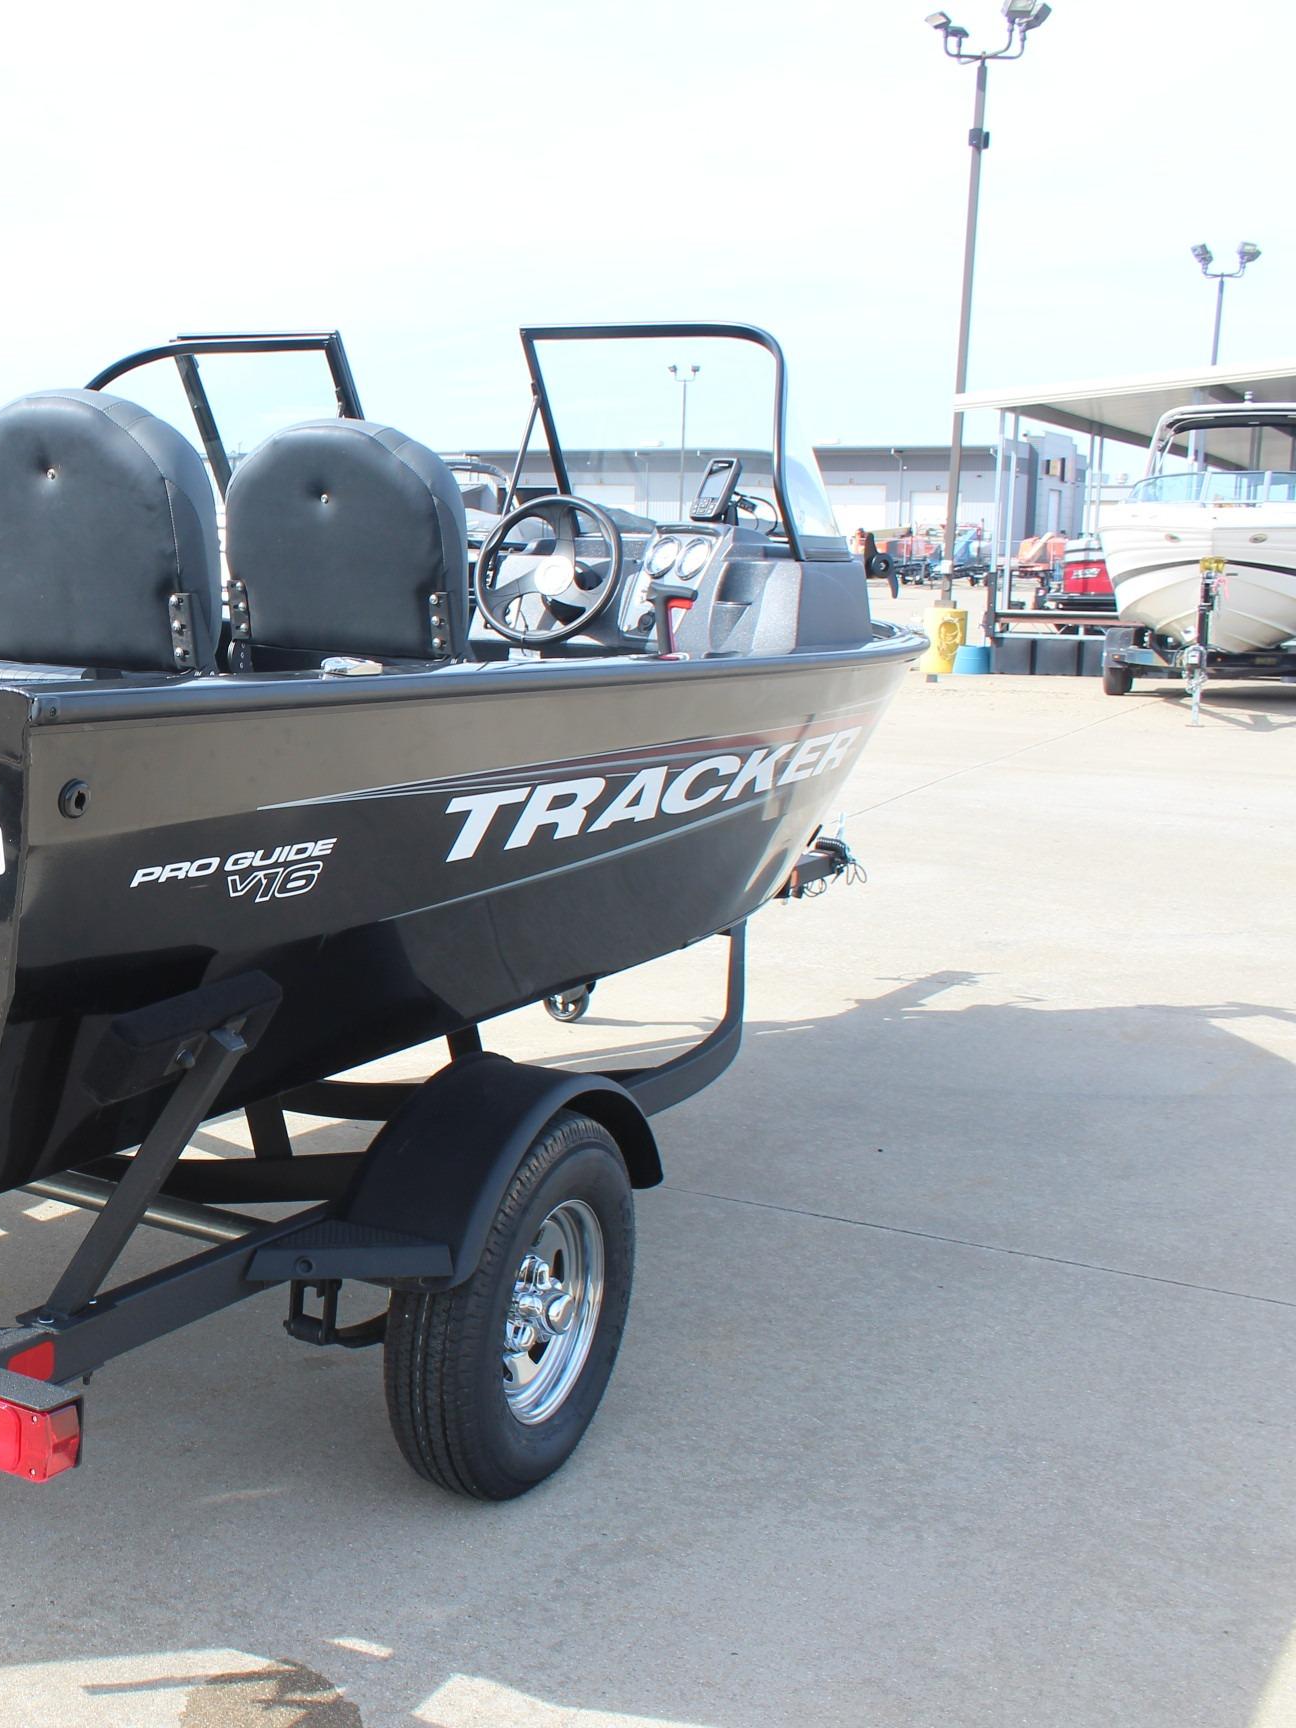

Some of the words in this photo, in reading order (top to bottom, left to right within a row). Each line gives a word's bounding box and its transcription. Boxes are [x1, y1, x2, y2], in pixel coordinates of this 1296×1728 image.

[445, 726, 862, 863] TRACKER
[129, 857, 221, 888] PRO
[224, 837, 338, 872] GUIDE
[227, 860, 324, 903] V16
